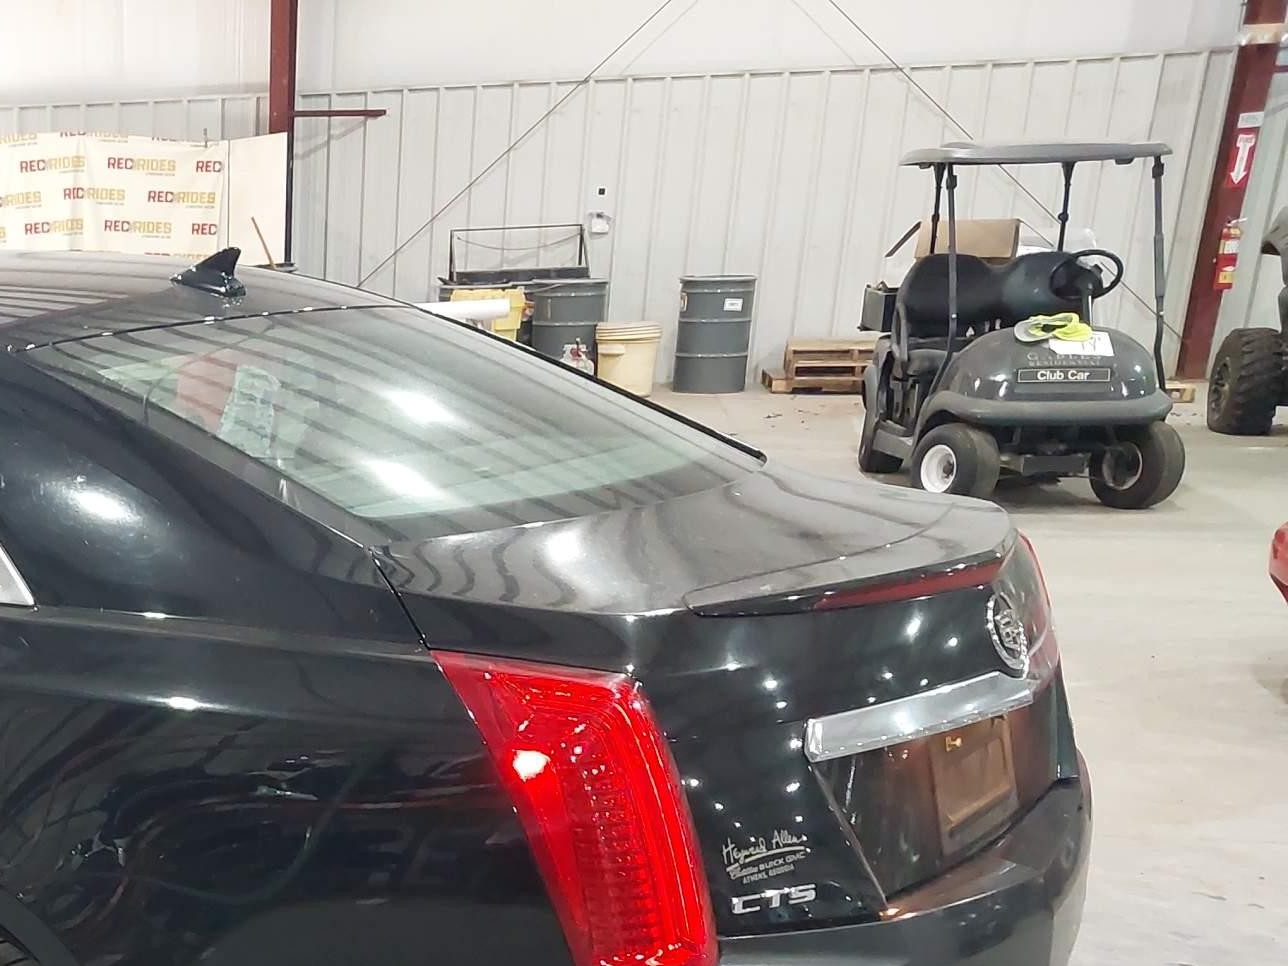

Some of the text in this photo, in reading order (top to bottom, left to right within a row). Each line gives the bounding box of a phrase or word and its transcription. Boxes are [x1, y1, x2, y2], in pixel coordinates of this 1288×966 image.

[1037, 370, 1090, 380] Club Car
[785, 851, 806, 863] GMC
[731, 883, 816, 914] CTS
